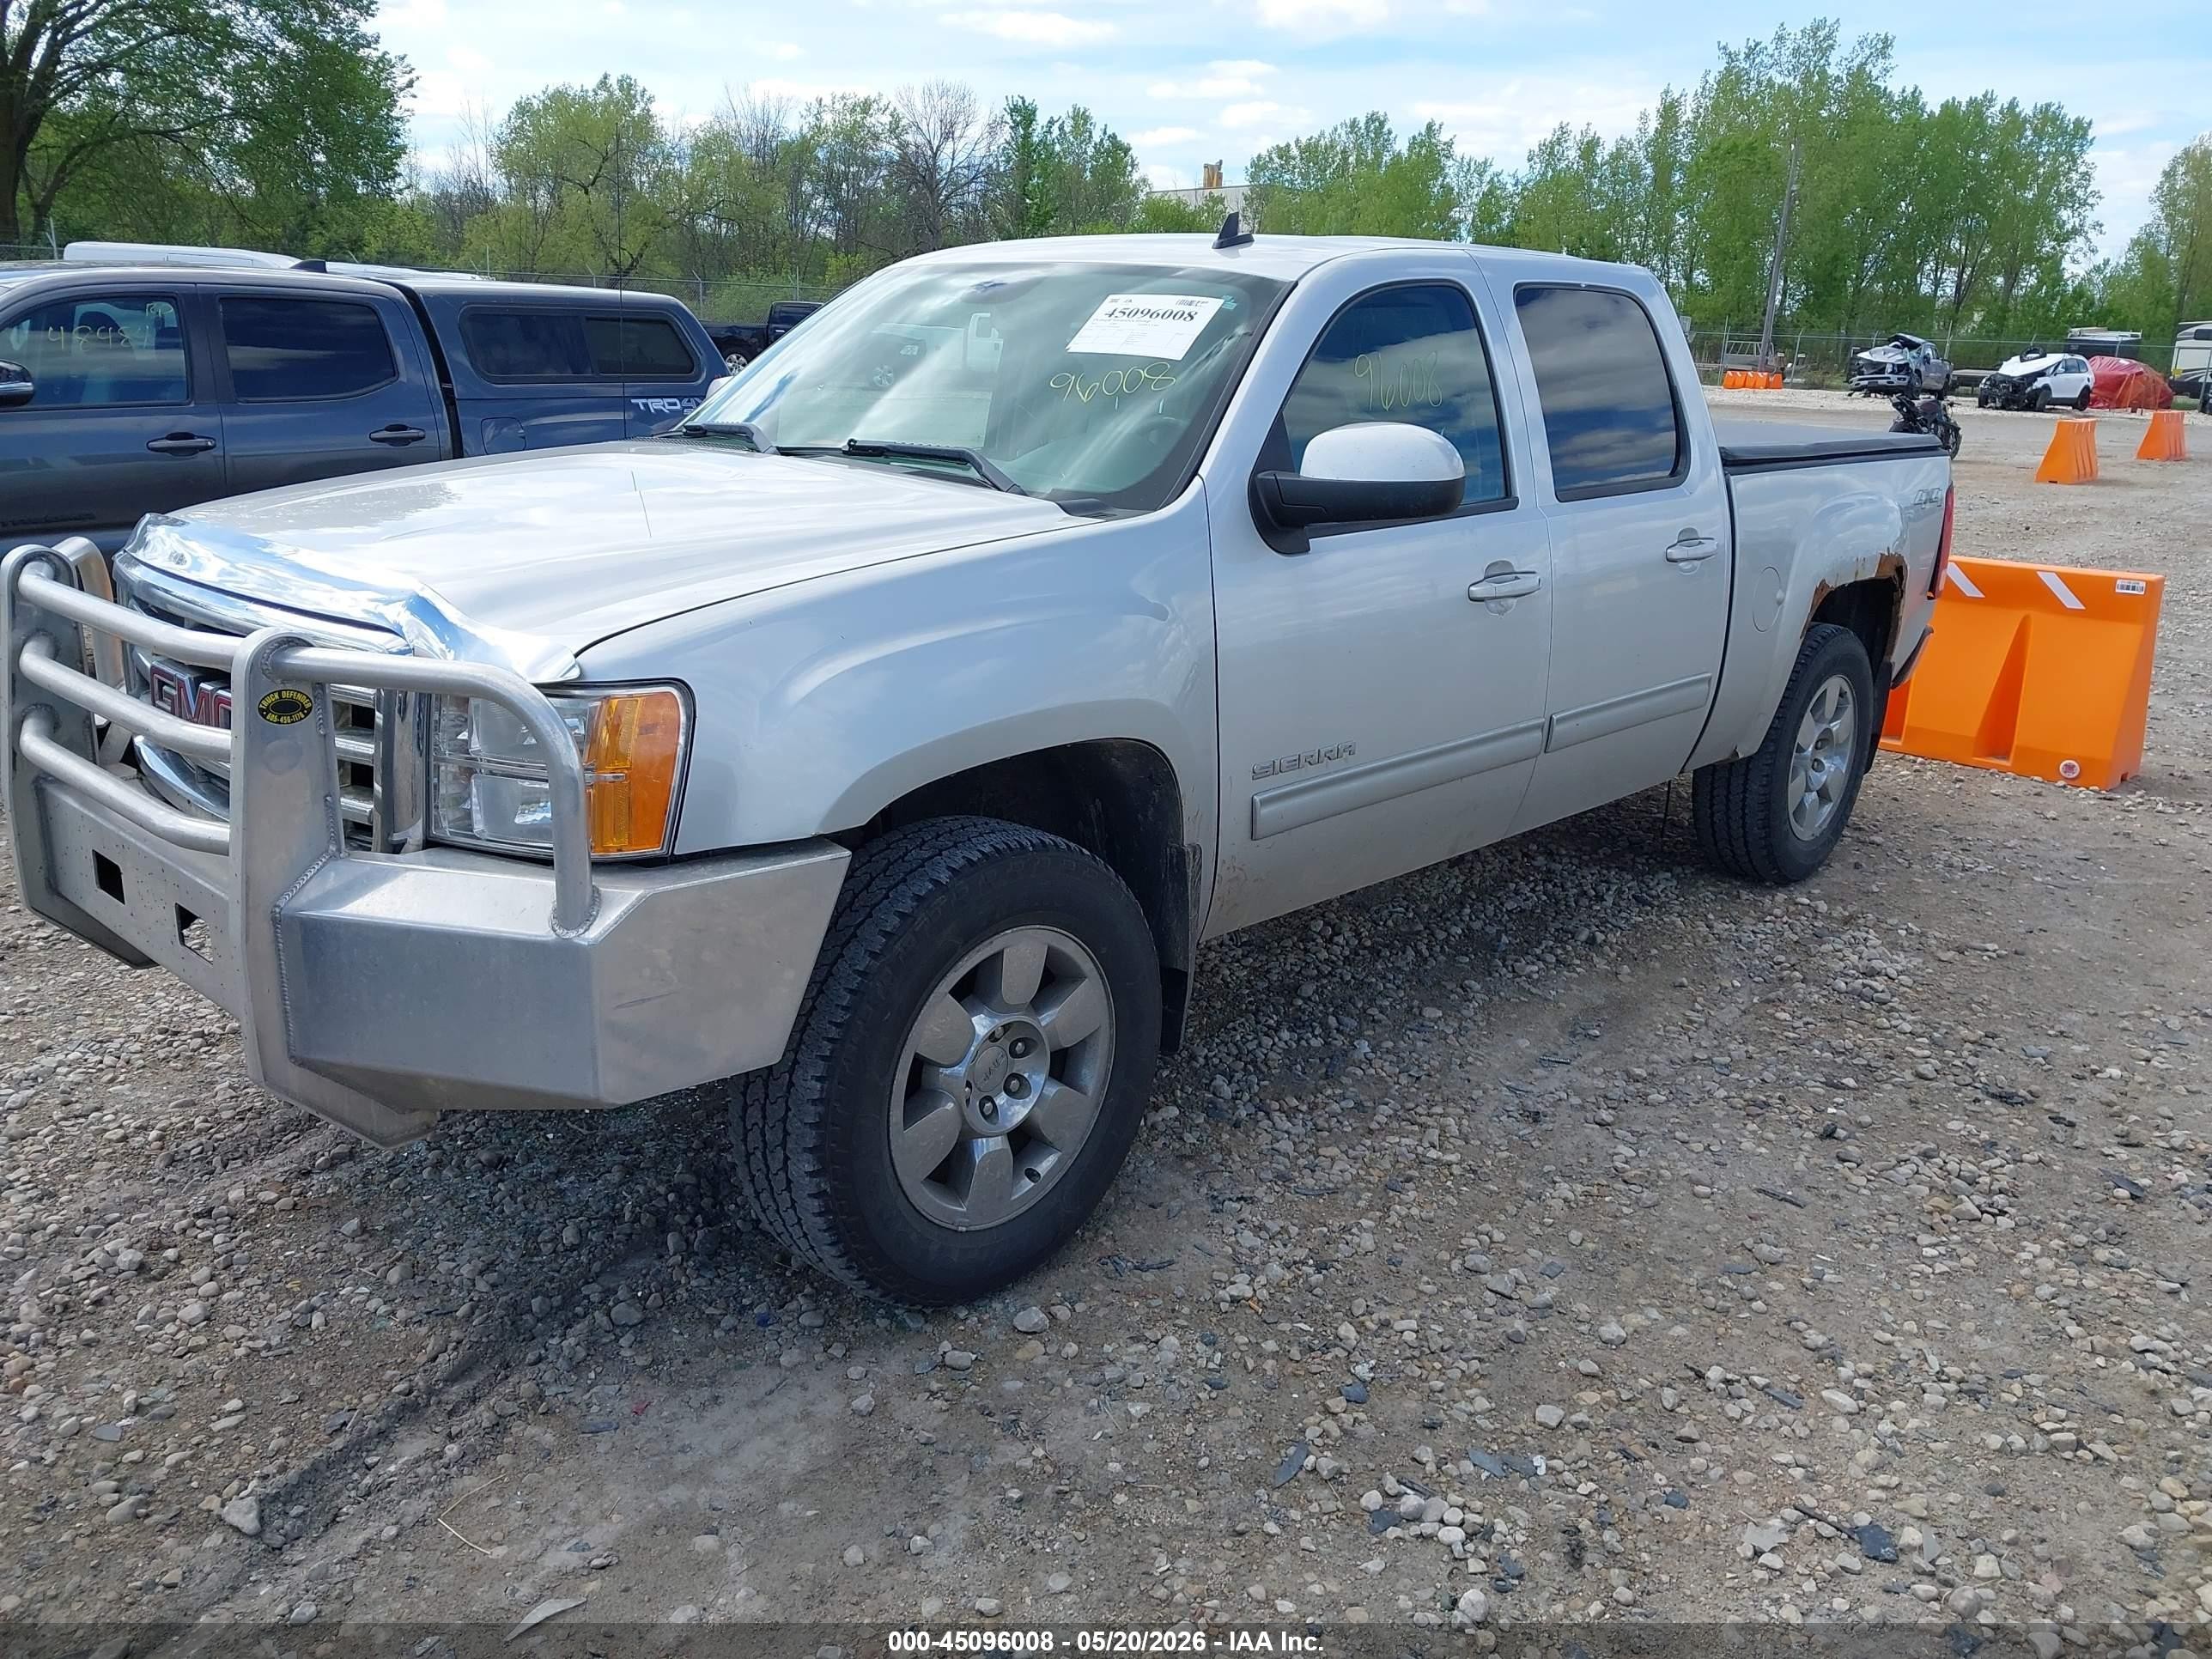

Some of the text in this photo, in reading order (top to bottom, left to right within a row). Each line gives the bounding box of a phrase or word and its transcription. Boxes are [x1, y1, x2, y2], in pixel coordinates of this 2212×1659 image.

[1104, 307, 1198, 323] 45096008
[1049, 362, 1176, 403] 96008
[1355, 350, 1443, 411] 96008
[630, 398, 682, 413] TRD
[258, 690, 312, 709] TRUCK DEFENDER
[1251, 739, 1356, 781] SIERRA
